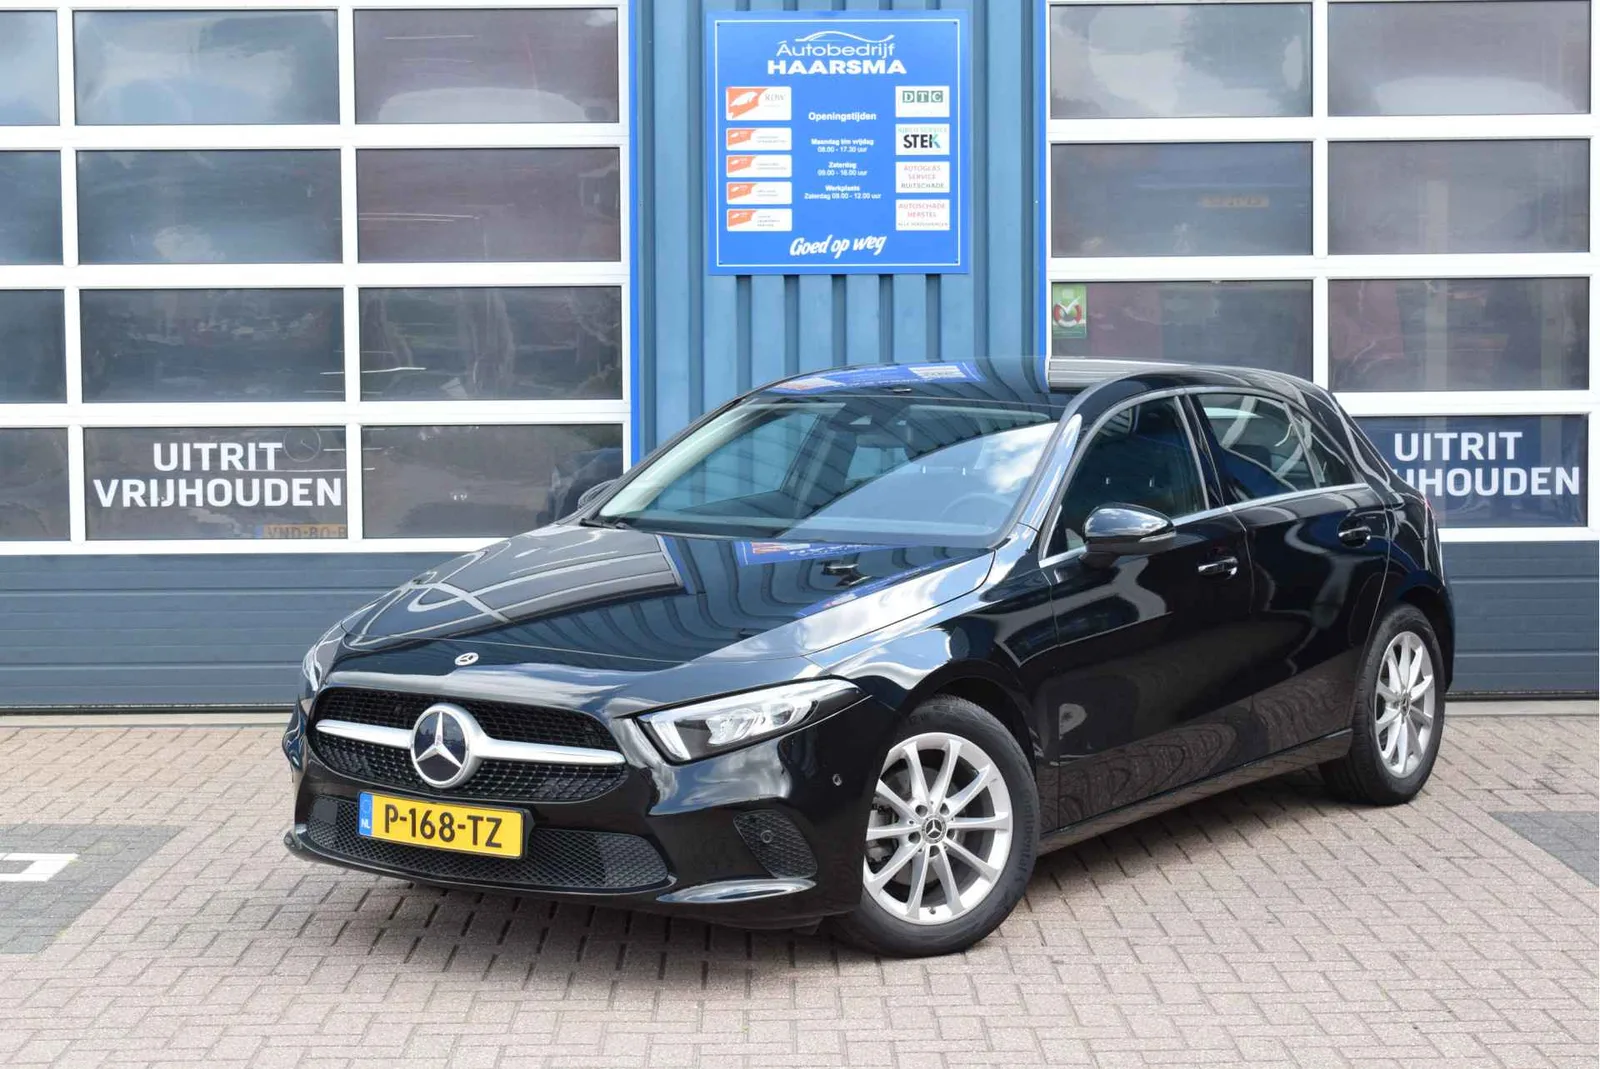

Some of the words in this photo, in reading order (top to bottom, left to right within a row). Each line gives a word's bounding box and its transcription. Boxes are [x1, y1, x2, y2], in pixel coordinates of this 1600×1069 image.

[776, 41, 895, 58] Autobedrijf
[767, 59, 907, 75] HAARSMA
[902, 90, 943, 103] DTC
[808, 112, 877, 123] Openingstijden
[811, 138, 840, 146] Maandag
[852, 138, 874, 146] vrijdag
[903, 134, 941, 149] STEK
[828, 161, 857, 169] Zaterdag
[804, 192, 831, 200] Zaterdag
[790, 234, 833, 256] Goed
[829, 240, 849, 259] op
[853, 234, 887, 256] weg
[1394, 431, 1523, 462] UITRIT
[153, 442, 283, 472] UITRIT
[93, 478, 342, 508] VRIJHOUDEN
[361, 818, 370, 829] NL
[384, 803, 503, 849] P-168-TZ
